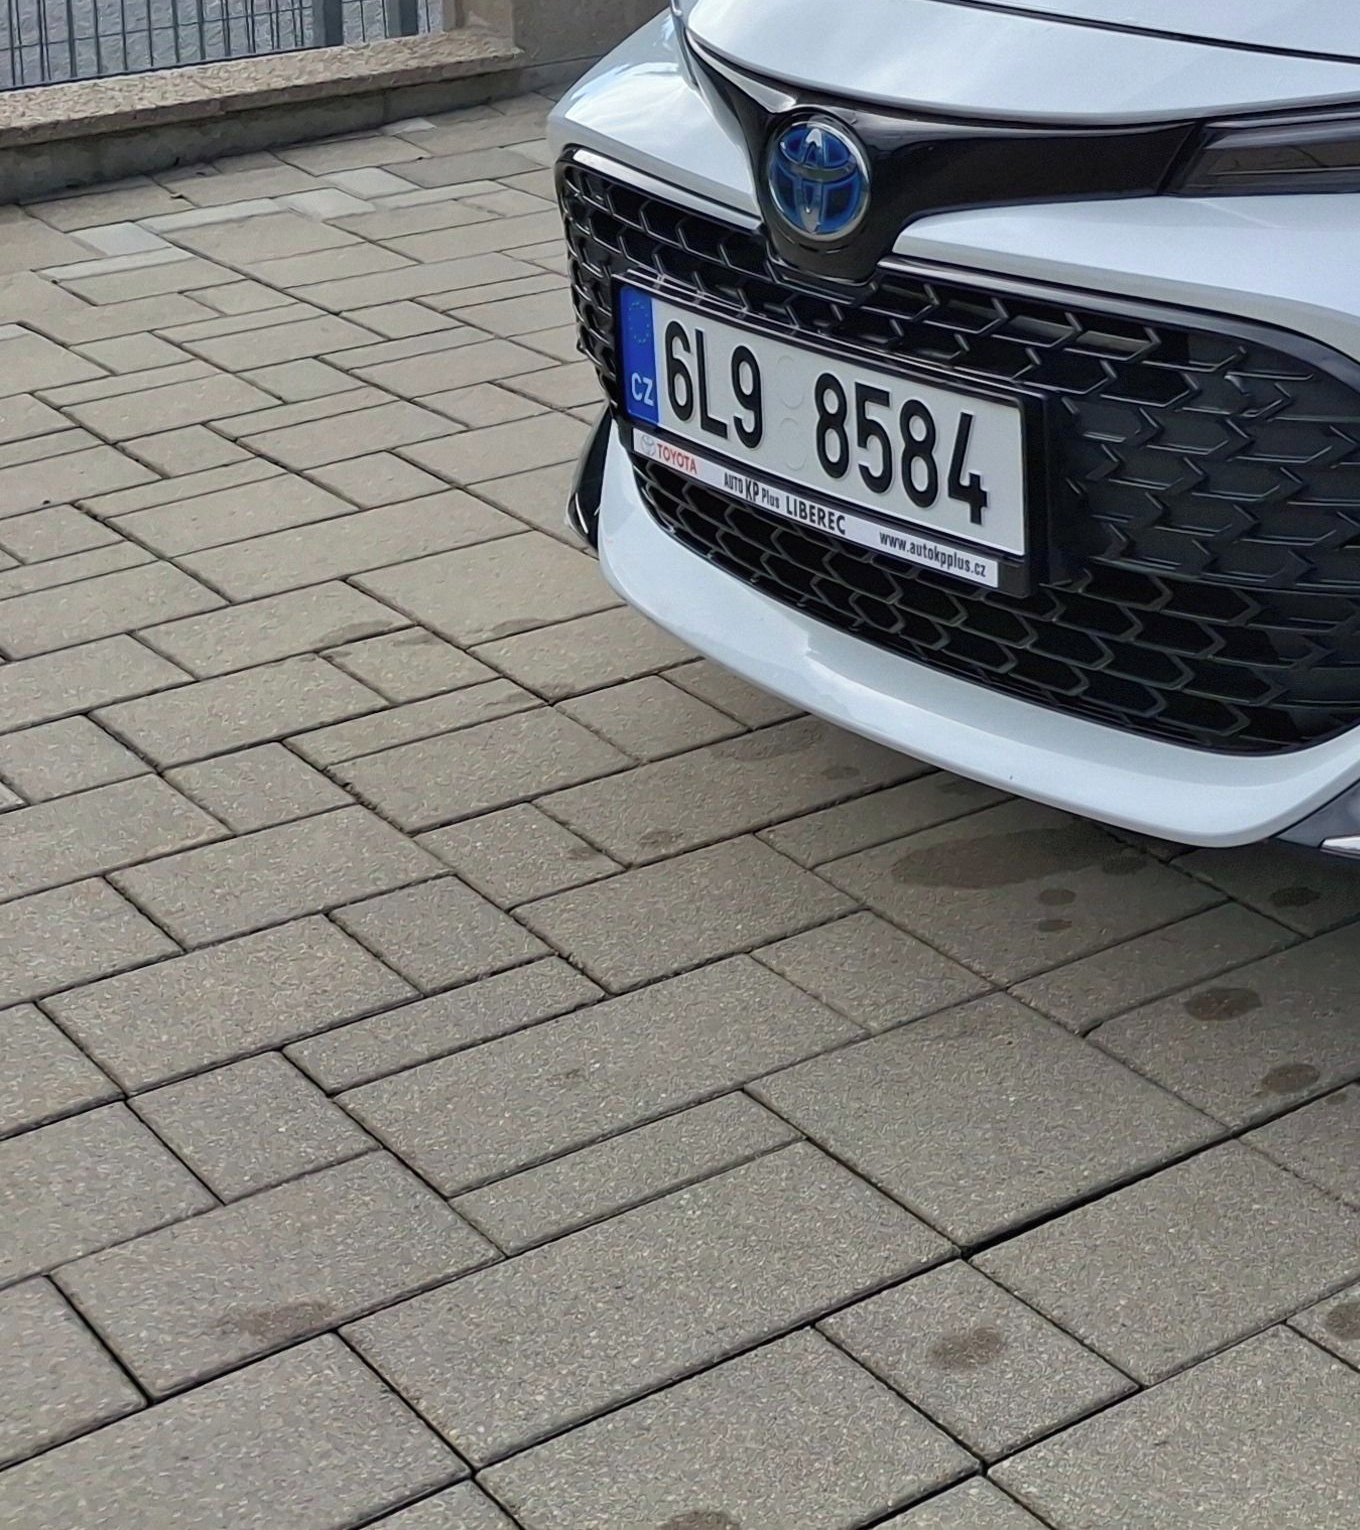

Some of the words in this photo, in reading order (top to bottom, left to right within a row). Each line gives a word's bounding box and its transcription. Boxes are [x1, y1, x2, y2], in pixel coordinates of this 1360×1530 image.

[631, 372, 654, 407] CZ
[664, 320, 763, 449] 6L9
[815, 372, 988, 526] 8584
[656, 443, 697, 475] TOYOTA
[723, 471, 744, 492] AUTO
[744, 479, 760, 503] KP
[761, 488, 780, 509] Plus
[785, 496, 846, 536] LIBEREC
[879, 531, 986, 578] www.autokpplus.cz
